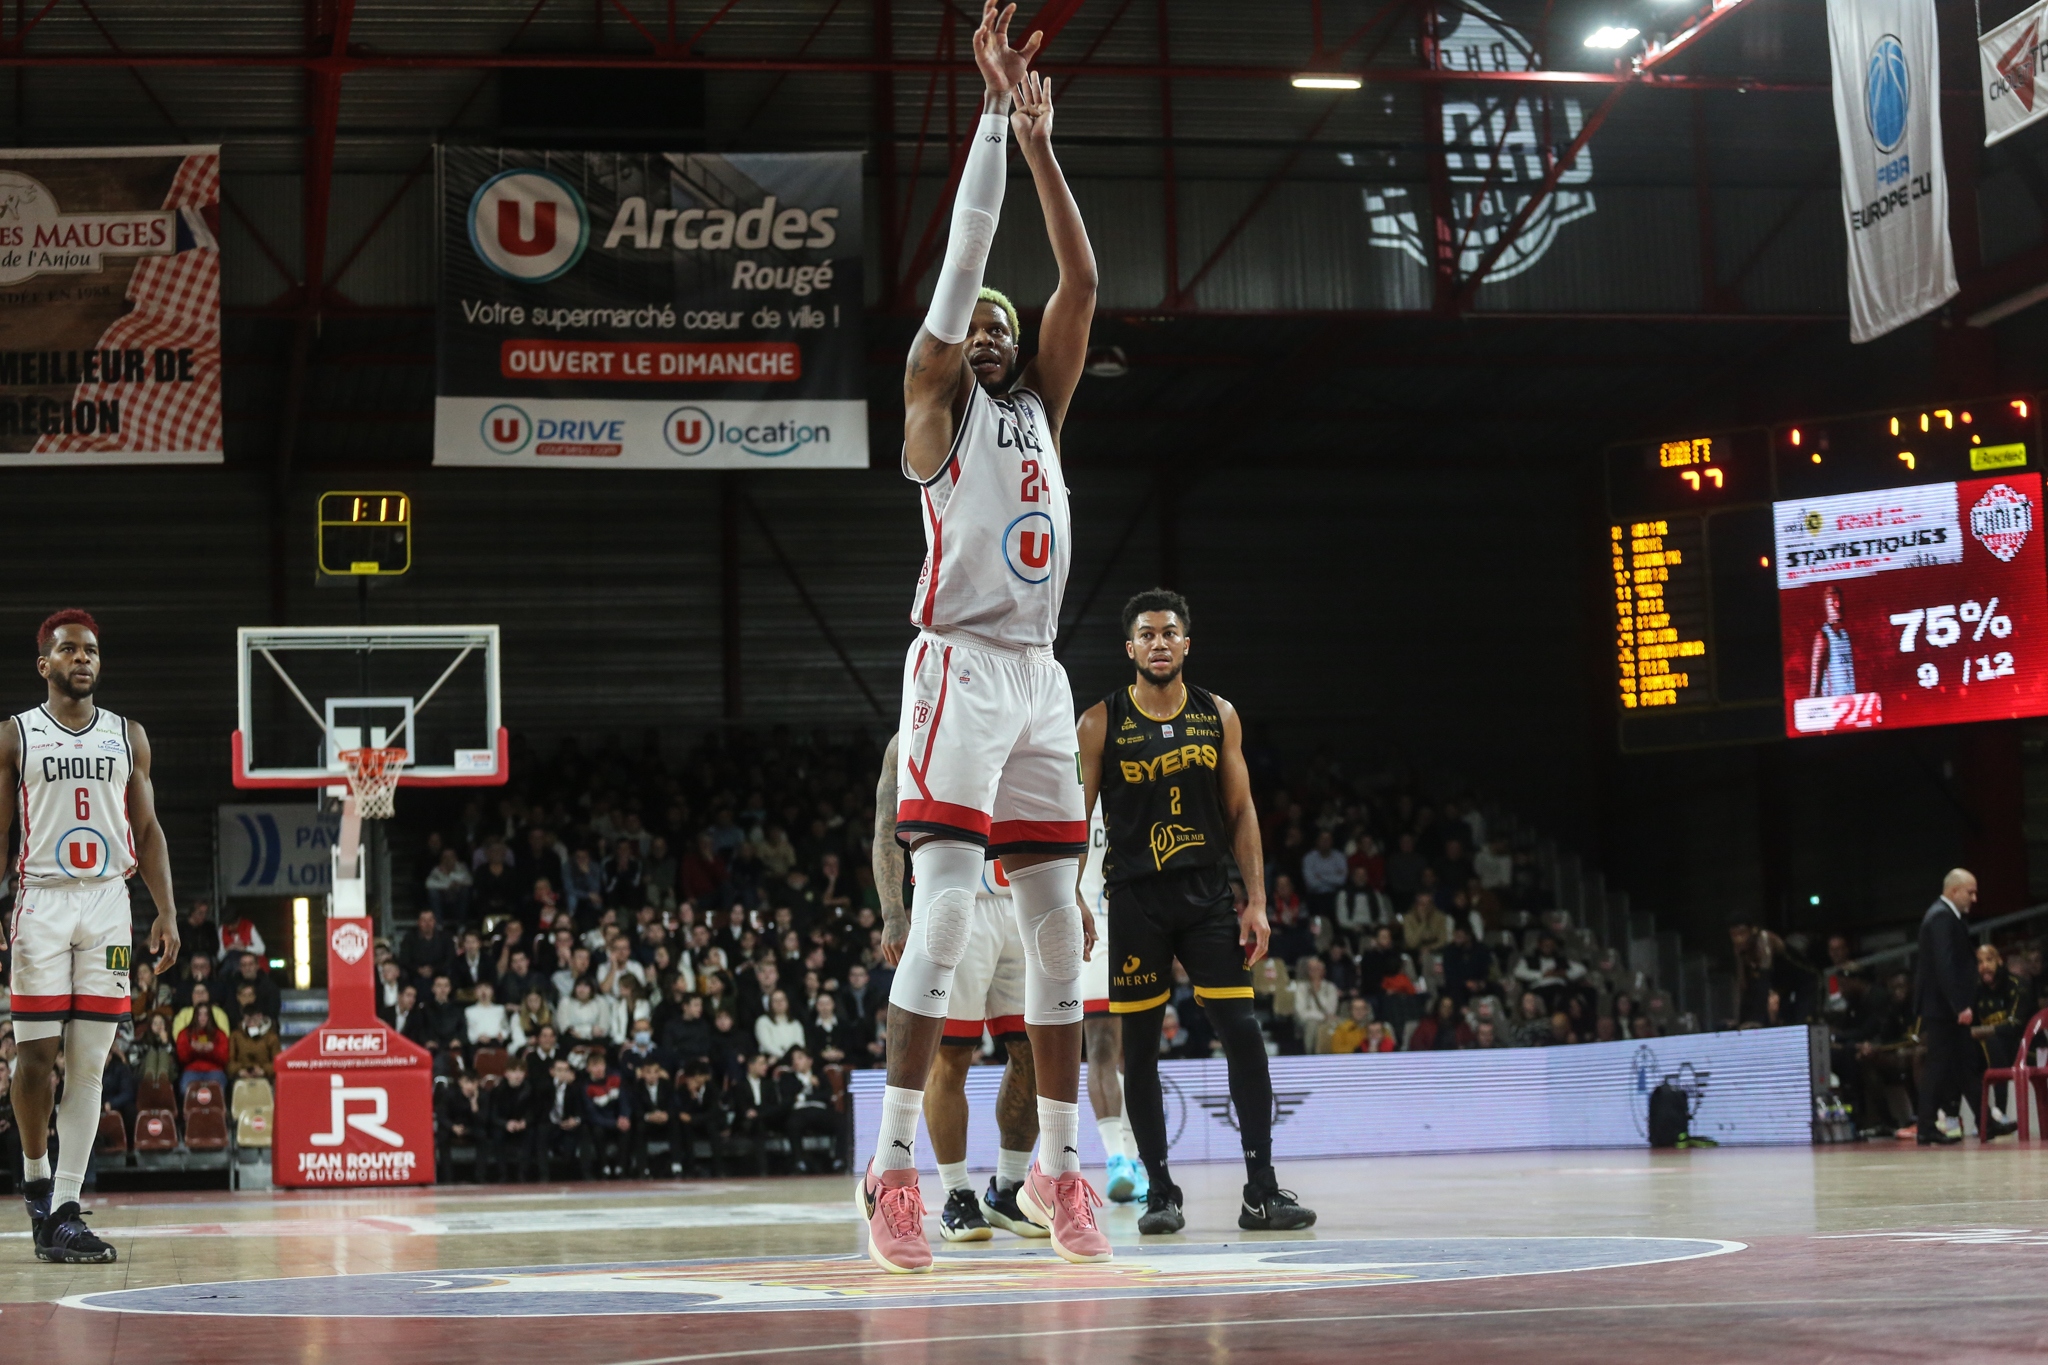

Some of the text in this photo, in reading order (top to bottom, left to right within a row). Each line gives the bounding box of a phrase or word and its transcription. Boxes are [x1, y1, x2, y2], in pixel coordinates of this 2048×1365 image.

[1851, 185, 1908, 231] EUROPE
[33, 218, 167, 249] MAUGES
[497, 196, 839, 257] U Arcades
[1, 249, 91, 270] de l'Anjou
[731, 258, 834, 297] Rougé
[461, 300, 525, 325] Votre
[531, 303, 677, 331] supermarché
[751, 306, 781, 329] de
[789, 305, 825, 329] ville
[833, 305, 841, 329] !
[155, 347, 195, 383] DE
[509, 350, 795, 375] OUVERT LE DIMANCHE
[493, 418, 625, 443] U DRIVE
[676, 419, 831, 445] U location
[1020, 531, 1050, 568] U
[1786, 527, 1948, 569] STATISTIQUES
[1889, 596, 2013, 653] 75%
[1916, 662, 1940, 690] 9
[42, 756, 117, 783] CHOLET
[1120, 744, 1218, 784] BYERS
[74, 787, 90, 821] 6
[1169, 786, 1182, 816] 2
[1176, 834, 1190, 842] SUR
[68, 842, 98, 869] U
[1113, 972, 1157, 987] IMERYS
[325, 1034, 381, 1052] Betclic
[298, 1151, 416, 1172] JEAN ROUYER
[305, 1168, 410, 1182] AUTOMOBILES
